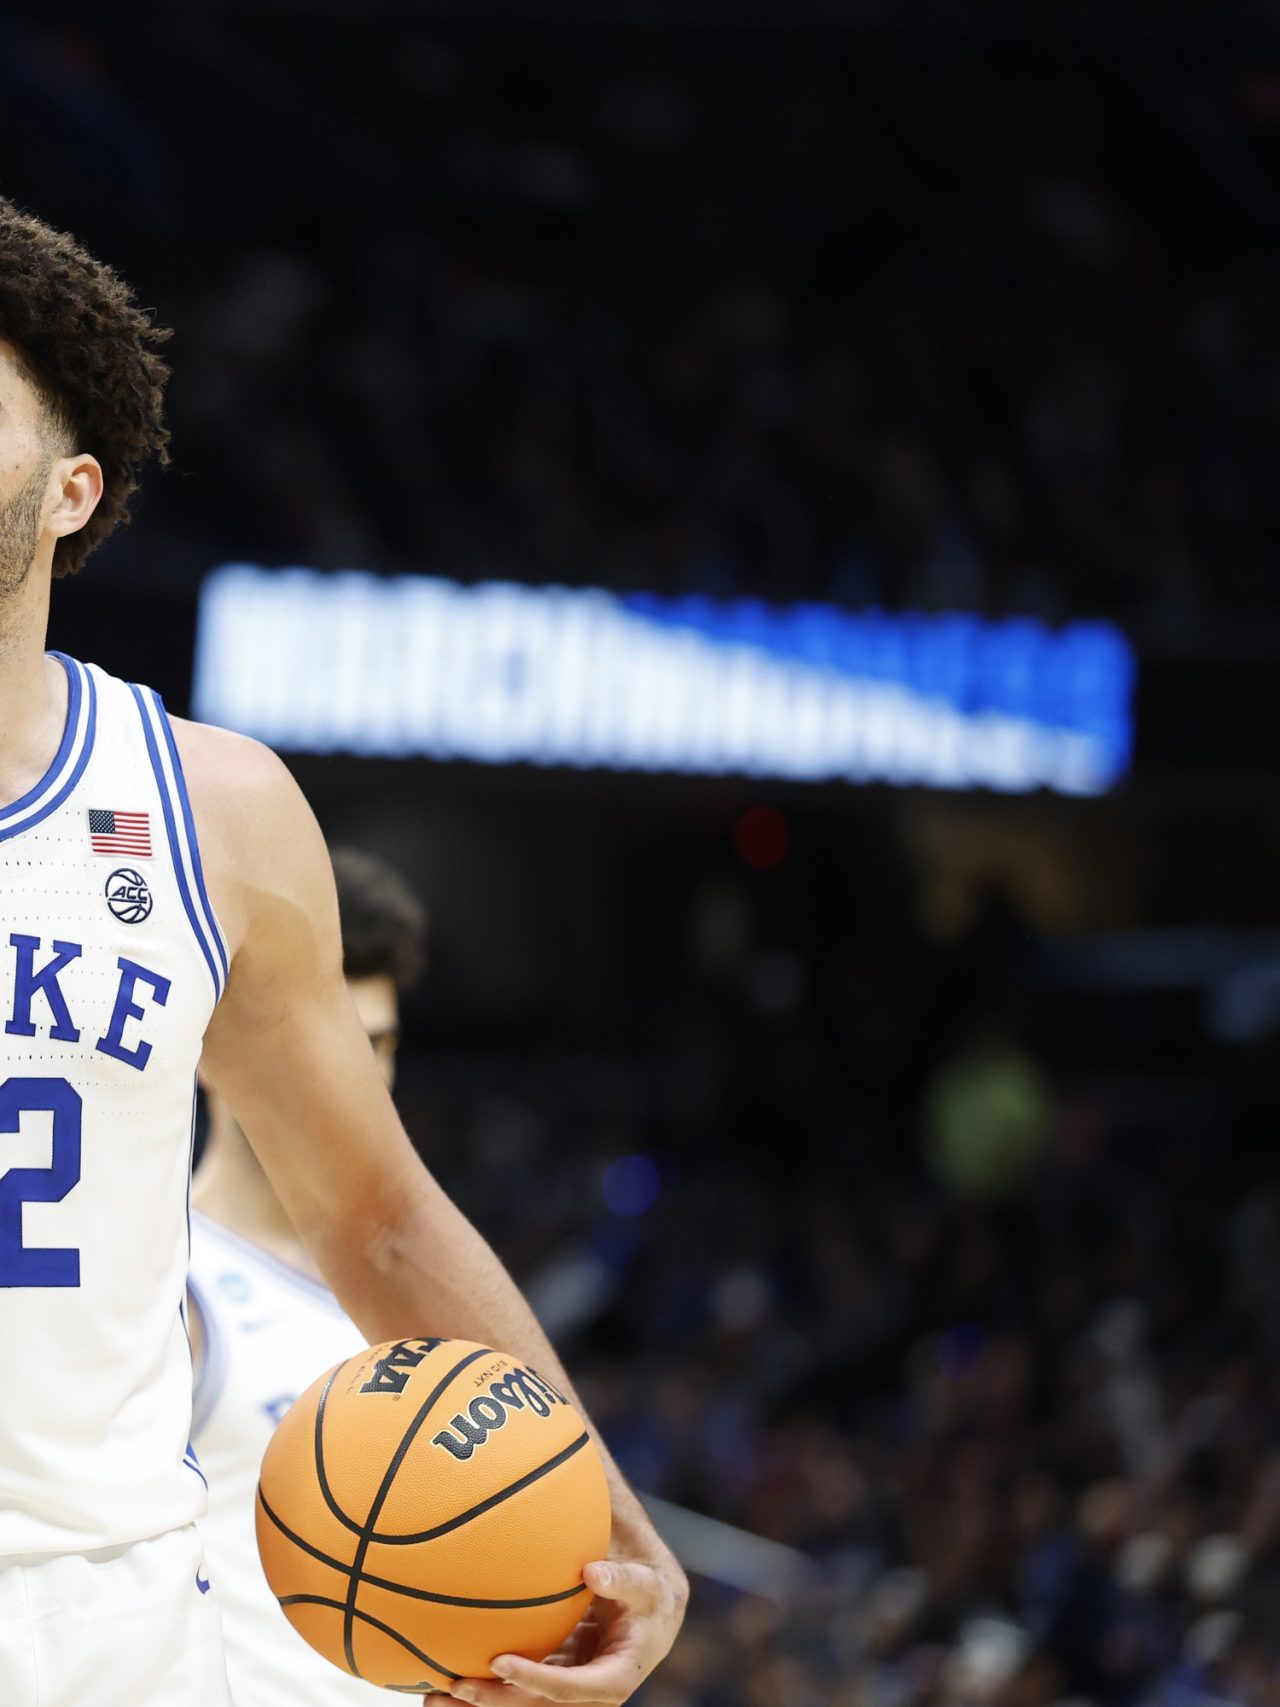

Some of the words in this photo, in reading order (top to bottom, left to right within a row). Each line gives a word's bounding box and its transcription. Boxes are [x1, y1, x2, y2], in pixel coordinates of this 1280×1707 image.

[111, 886, 149, 902] ACC
[358, 1337, 450, 1394] CAA
[430, 1365, 570, 1462] ilson
